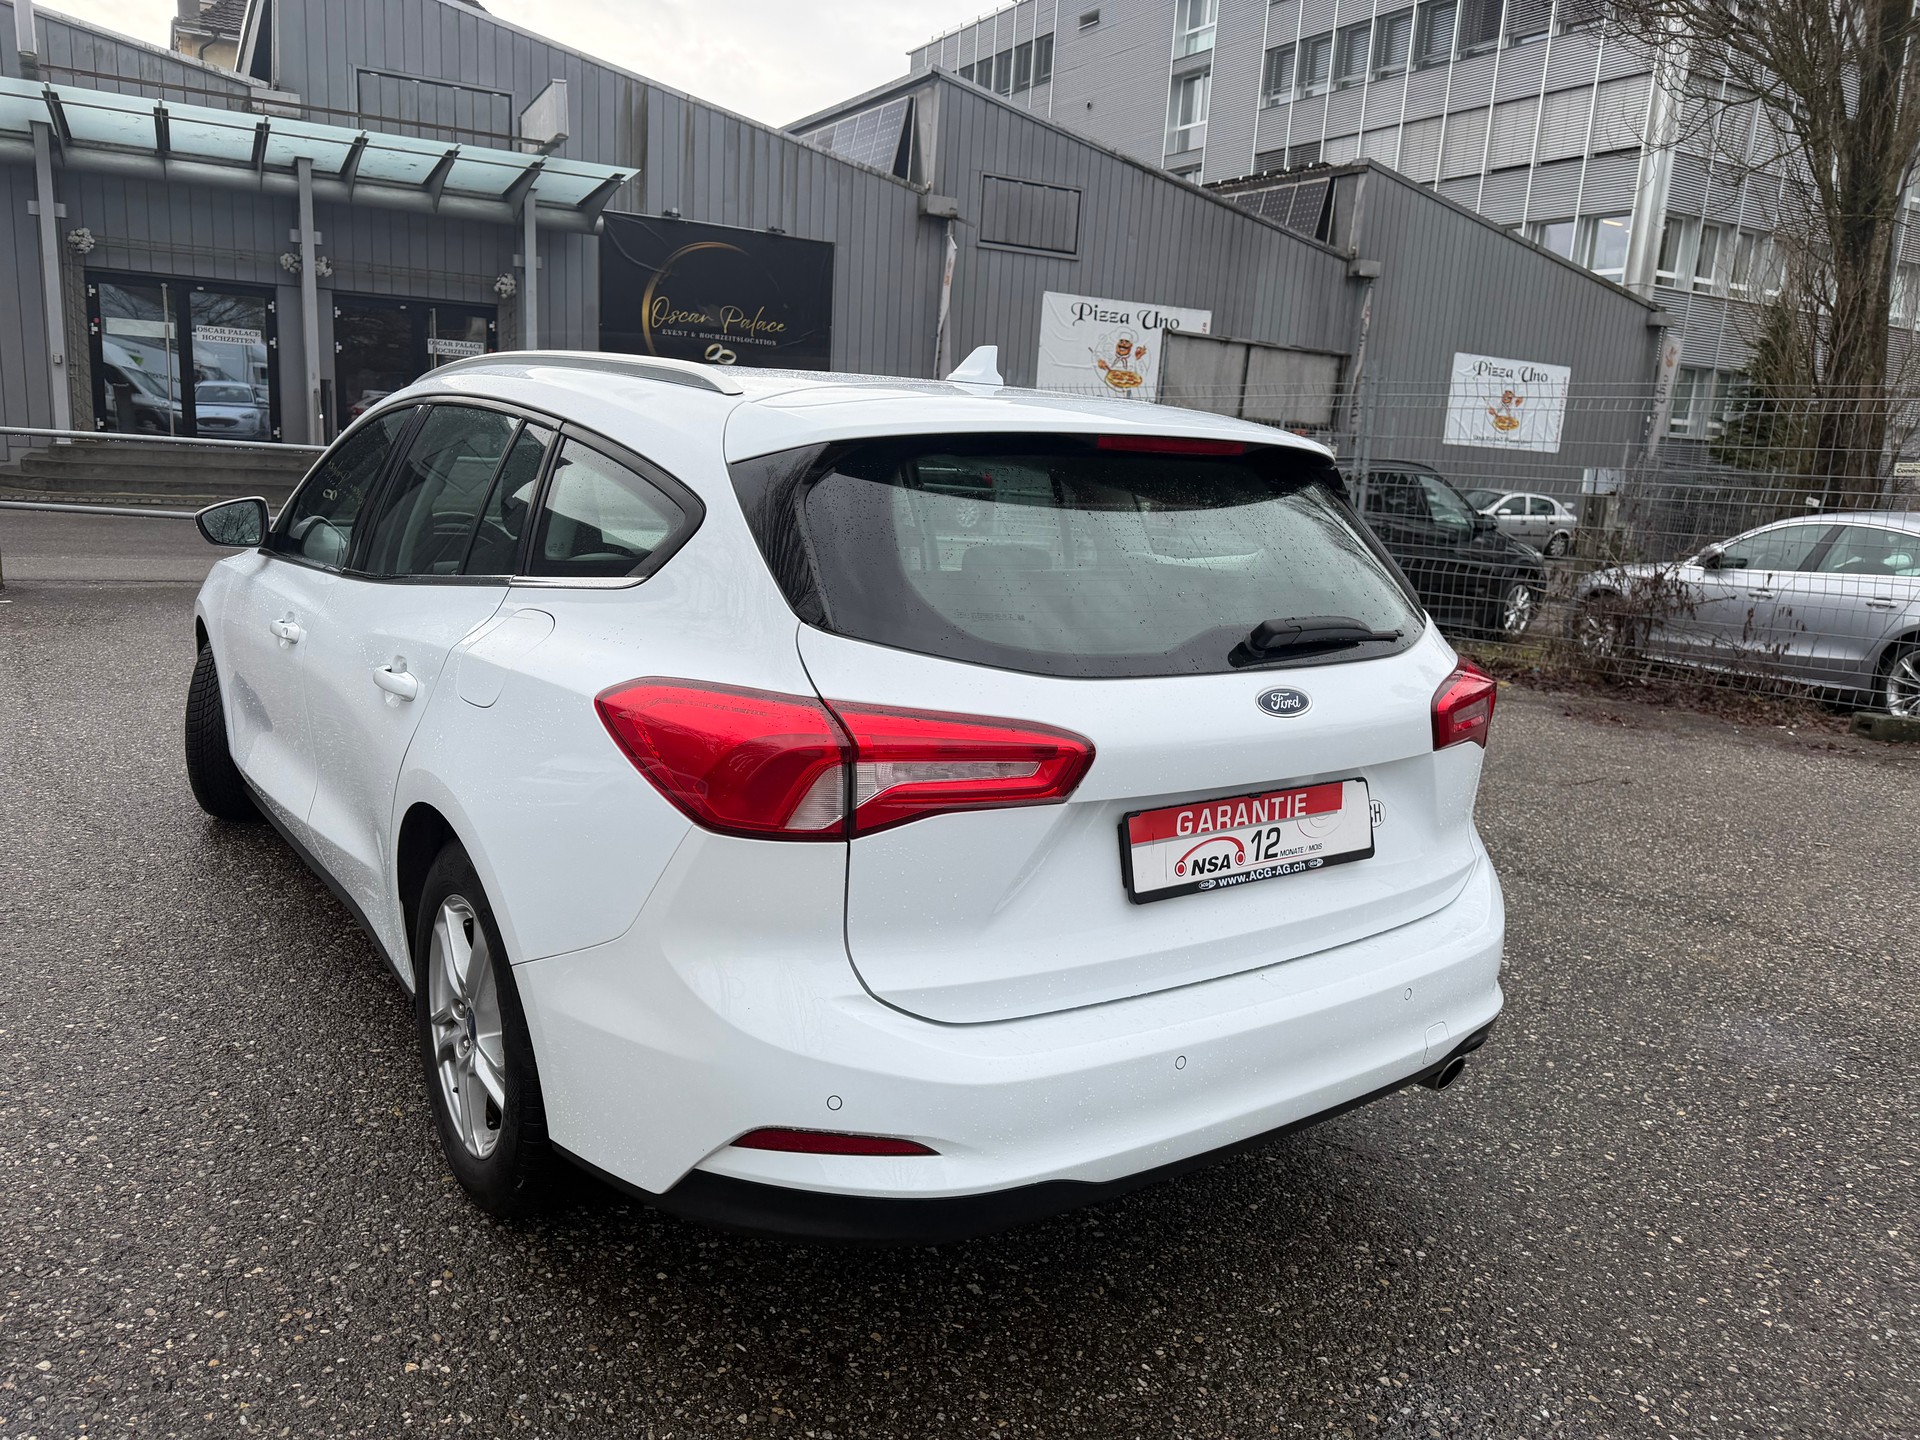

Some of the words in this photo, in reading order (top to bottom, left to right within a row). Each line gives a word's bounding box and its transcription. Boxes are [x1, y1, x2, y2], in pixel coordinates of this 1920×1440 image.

[651, 296, 715, 328] Oscar
[720, 305, 787, 337] Palace
[1071, 302, 1130, 326] Pizza
[1137, 309, 1180, 330] Uno
[197, 326, 226, 335] OSCAR
[228, 329, 261, 338] PALACE
[202, 334, 256, 344] HOCHZEITEN
[662, 329, 688, 337] EVENT
[699, 332, 777, 346] HOCHZEITSLOCATION
[455, 342, 483, 350] PALACE
[1472, 360, 1514, 381] Pizza
[1518, 366, 1548, 382] Uno
[1270, 692, 1301, 711] Ford
[1176, 793, 1307, 837] GARANTIE
[1250, 827, 1281, 861] 12
[1279, 846, 1304, 858] MONATE
[1308, 842, 1323, 851] MOIS
[1191, 853, 1231, 876] NSA
[1218, 861, 1306, 887] www.ACG-AG.ch
